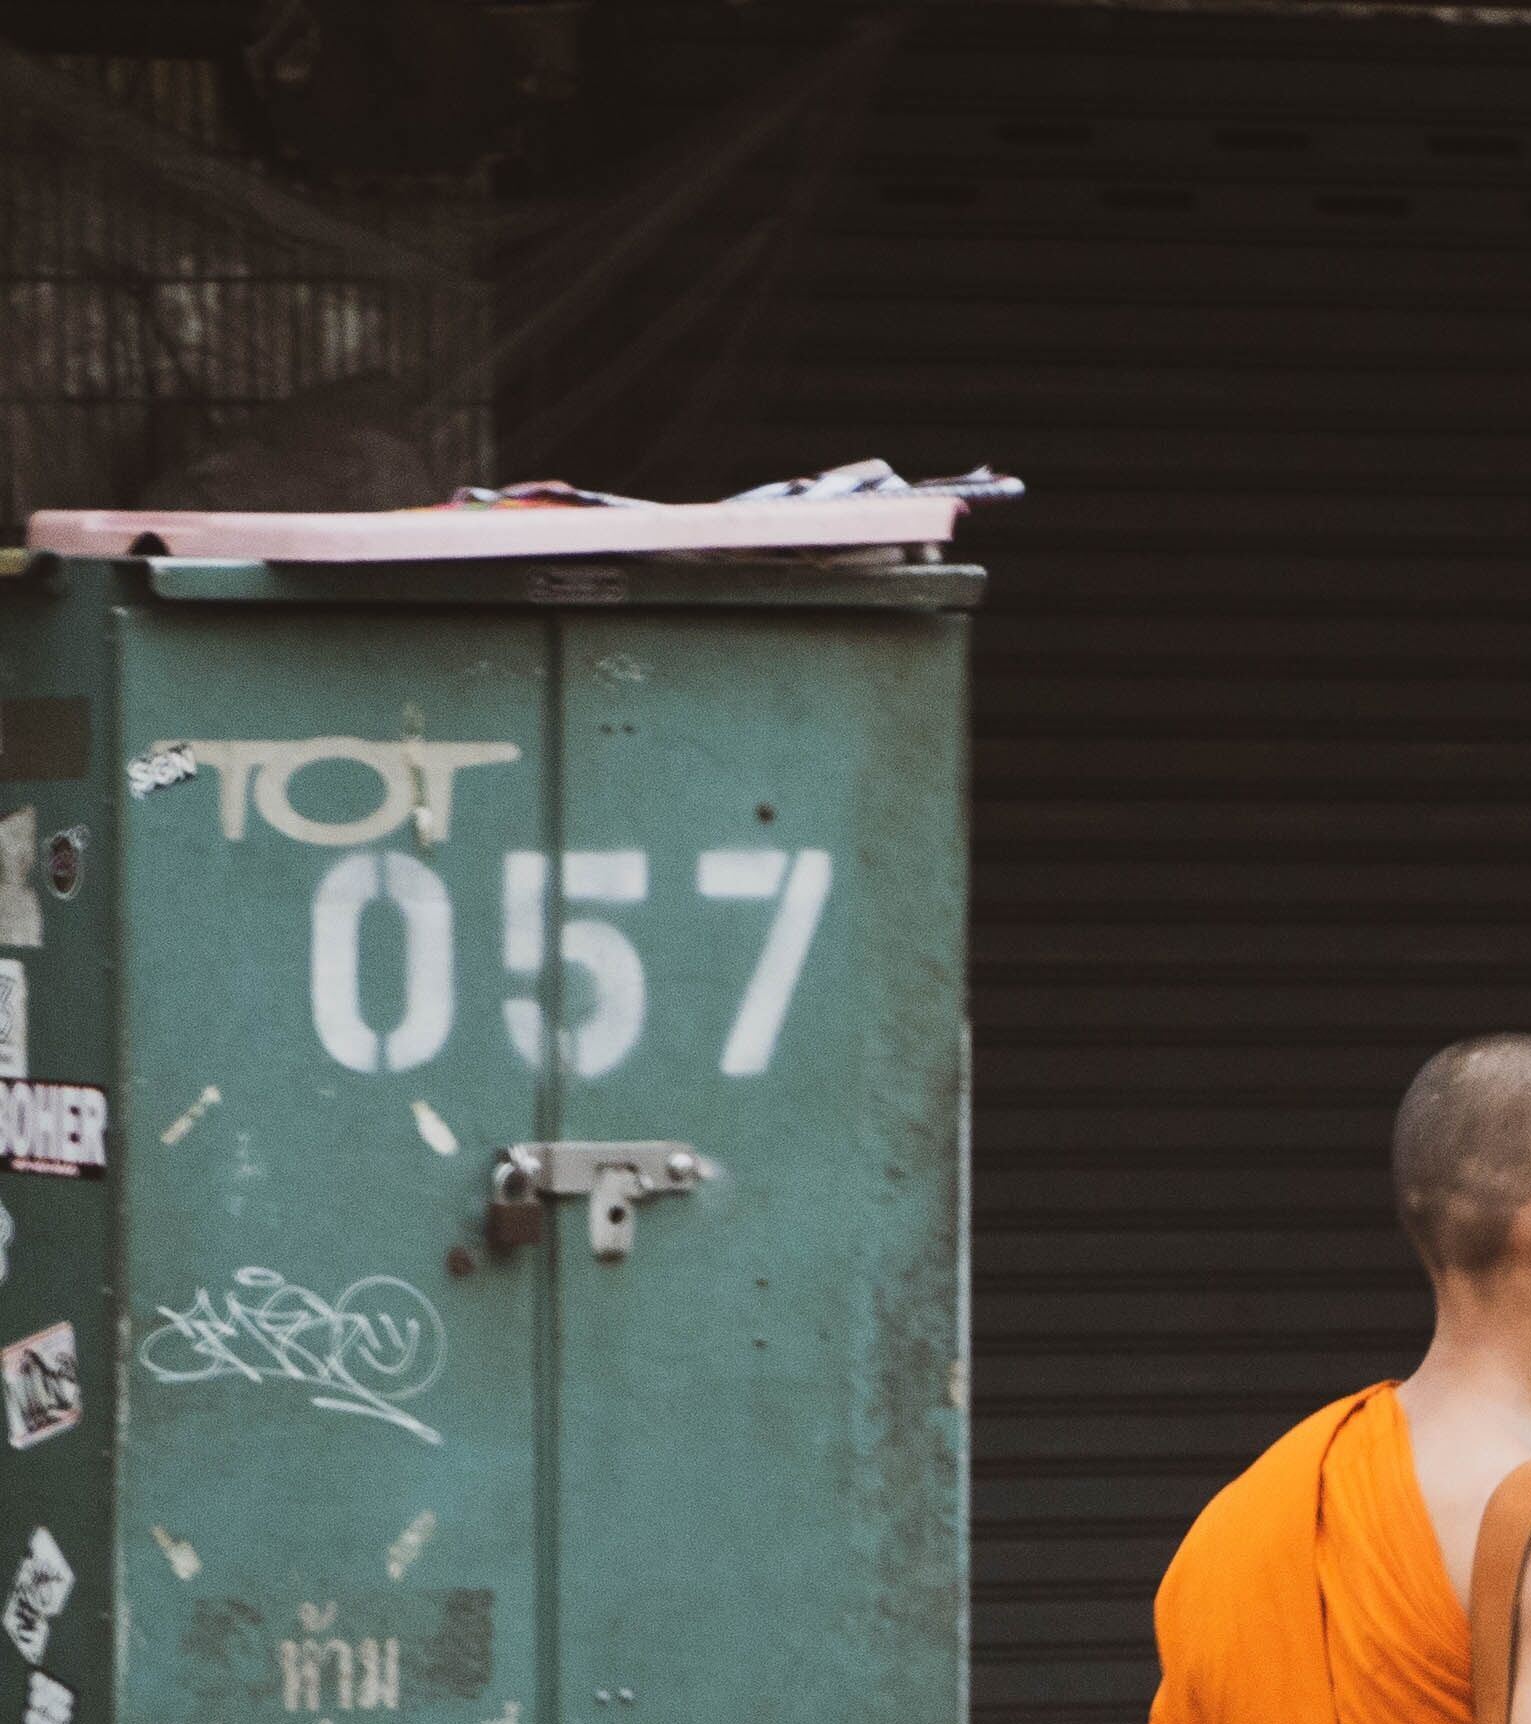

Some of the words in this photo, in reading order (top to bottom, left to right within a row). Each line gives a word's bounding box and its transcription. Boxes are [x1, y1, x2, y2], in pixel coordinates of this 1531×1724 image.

[152, 736, 521, 847] TOT
[311, 847, 833, 1078] 057
[281, 1600, 400, 1712] ห้าม
